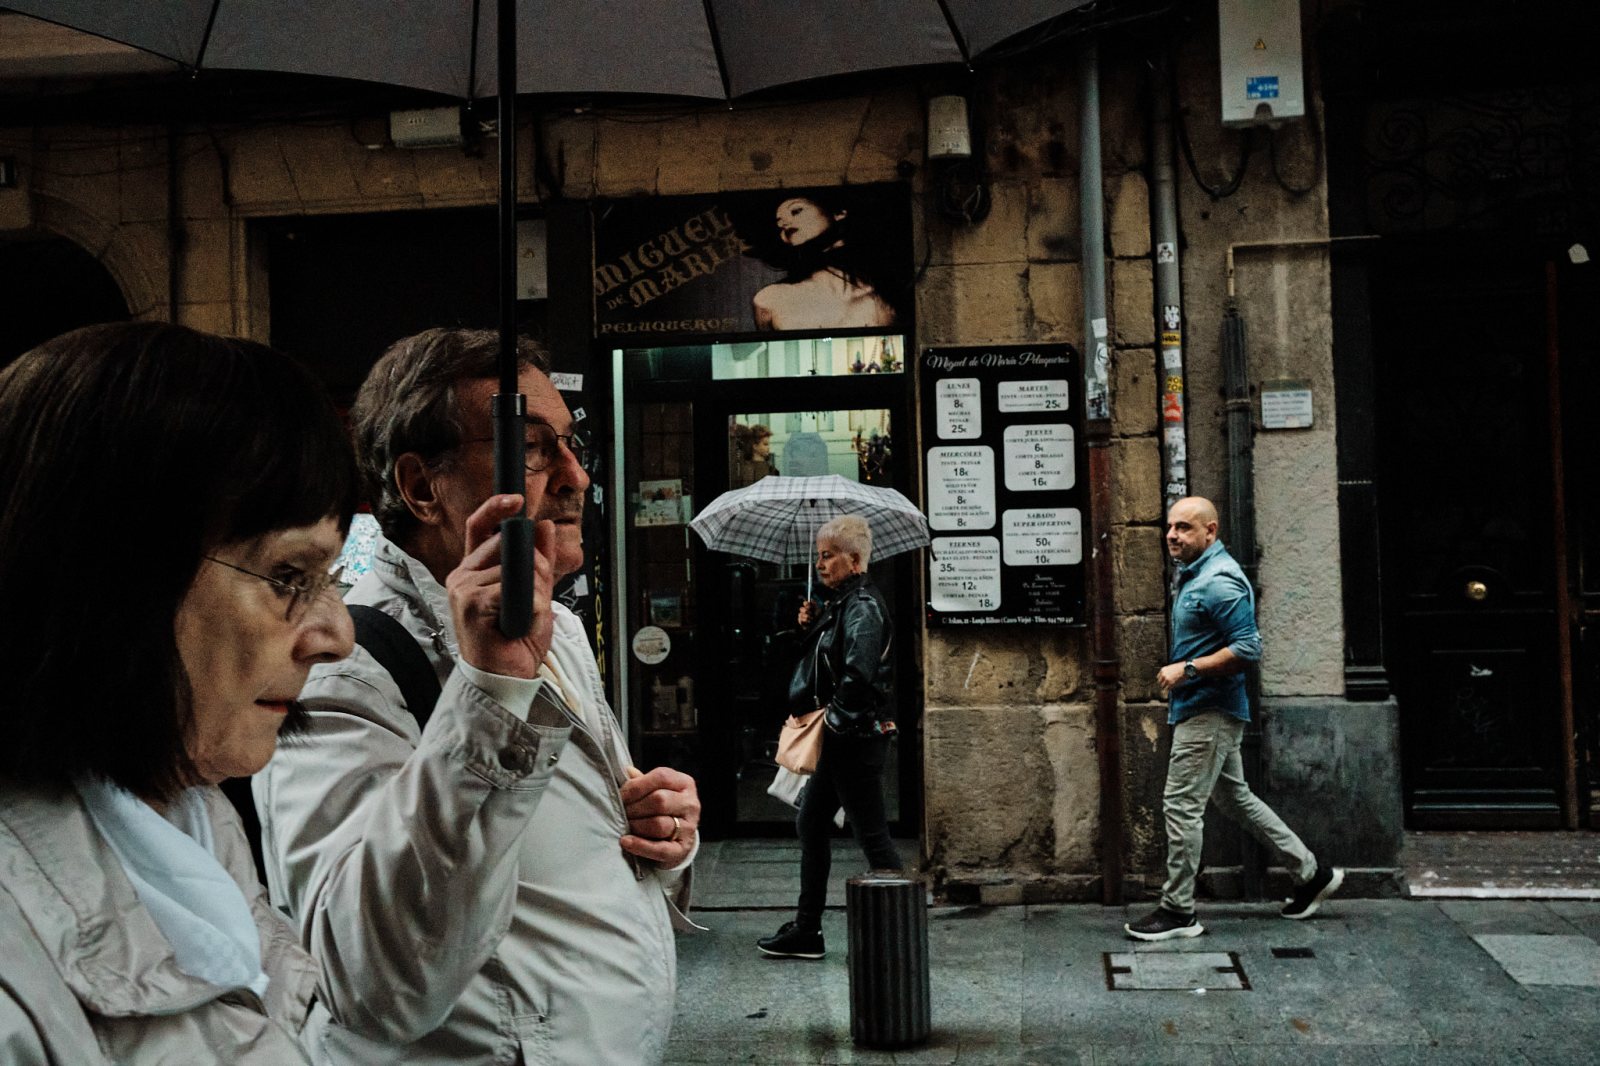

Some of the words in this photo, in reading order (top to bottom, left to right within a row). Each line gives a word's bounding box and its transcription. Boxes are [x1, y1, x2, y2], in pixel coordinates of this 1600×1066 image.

[595, 205, 734, 296] MIGUEL
[606, 294, 628, 310] DE
[629, 231, 752, 309] MARIA
[600, 318, 738, 333] PELUQUEROS
[926, 355, 968, 372] Miguel
[969, 356, 979, 367] de
[954, 399, 964, 408] 8€
[1045, 399, 1062, 409] 25€
[951, 424, 967, 433] 25€
[1025, 429, 1053, 437] JUEVES
[1034, 443, 1044, 452] 6€
[1034, 460, 1044, 469] 8€
[954, 467, 969, 477] 18€
[1032, 477, 1047, 486] 16€
[957, 496, 967, 504] 8€
[957, 518, 967, 527] 8€
[1035, 537, 1051, 547] 50€
[1035, 554, 1050, 564] 10€
[940, 563, 956, 572] 35€
[962, 581, 977, 590] 12€
[979, 599, 993, 608] 18€
